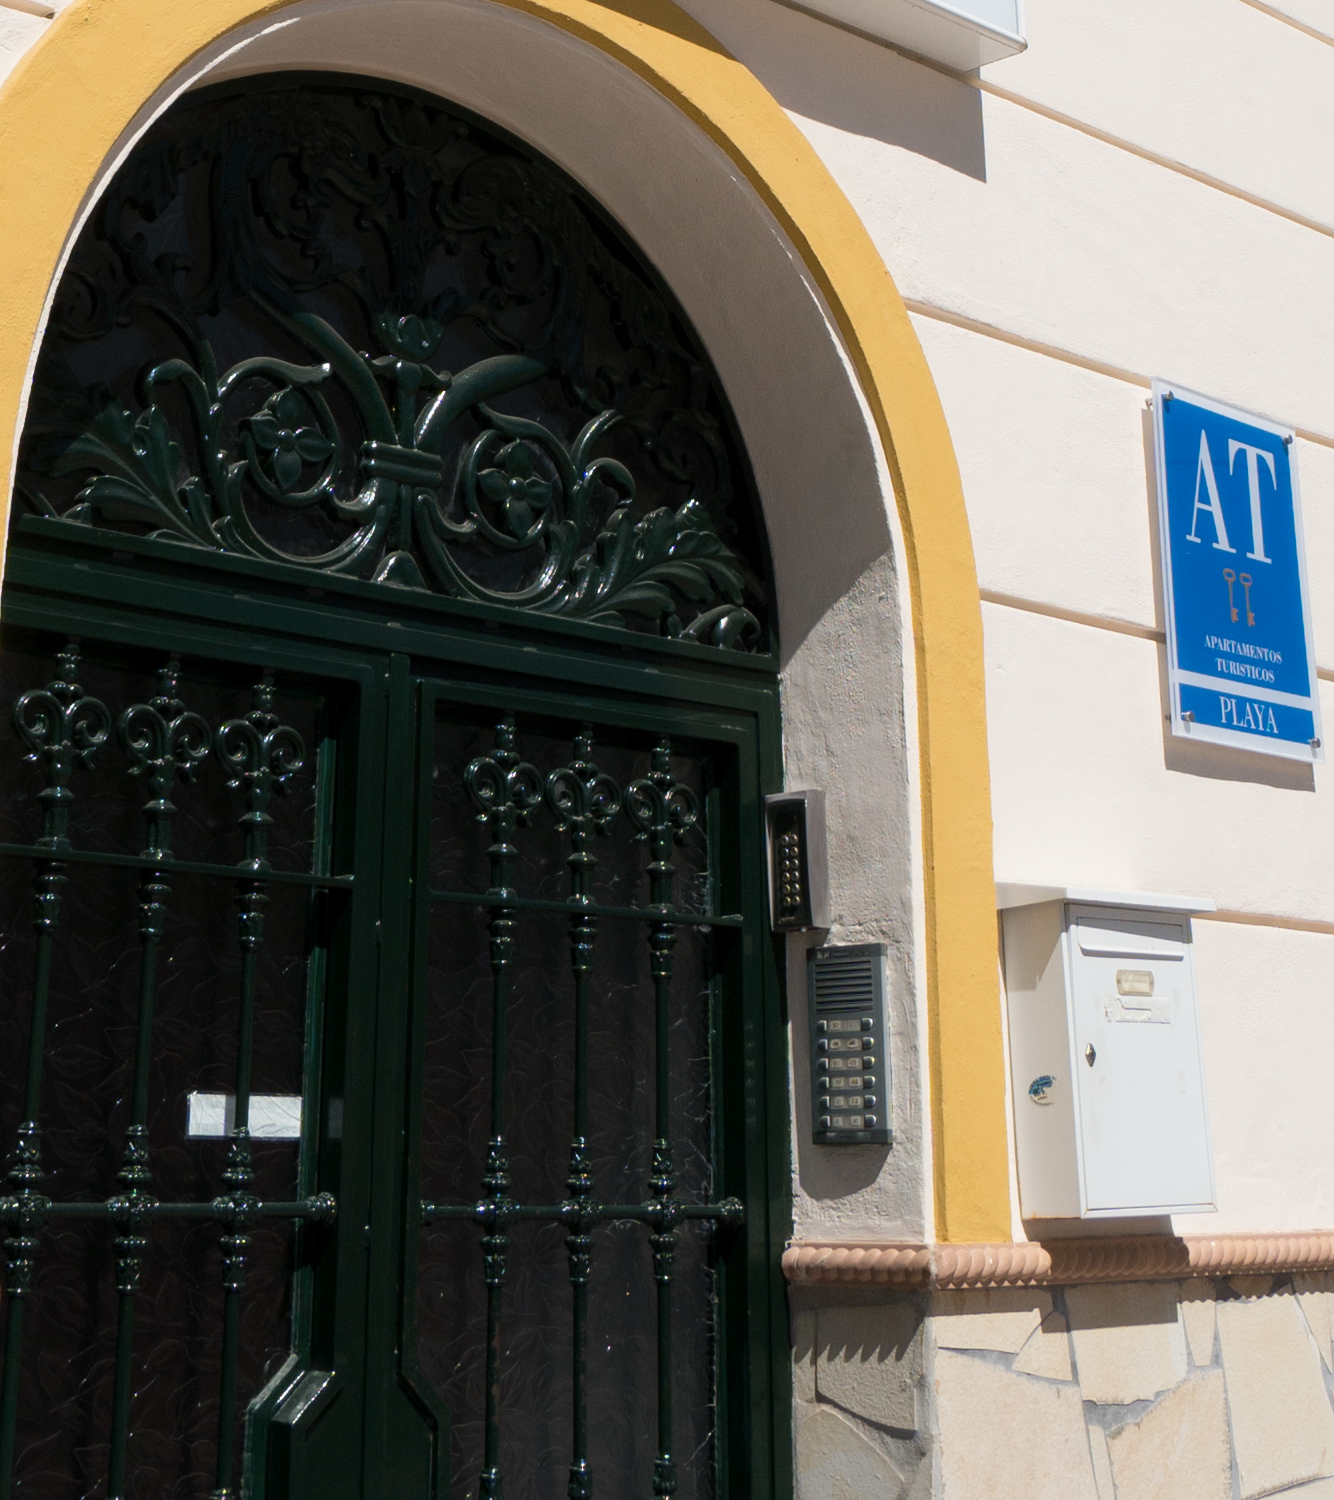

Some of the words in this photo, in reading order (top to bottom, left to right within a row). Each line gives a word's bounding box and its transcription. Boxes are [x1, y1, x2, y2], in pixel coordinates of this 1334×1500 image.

[1185, 428, 1277, 564] AT
[1204, 634, 1283, 664] APARTAMENTOS
[1214, 657, 1275, 683] TURISTICOS
[1219, 696, 1279, 734] PLAYA
